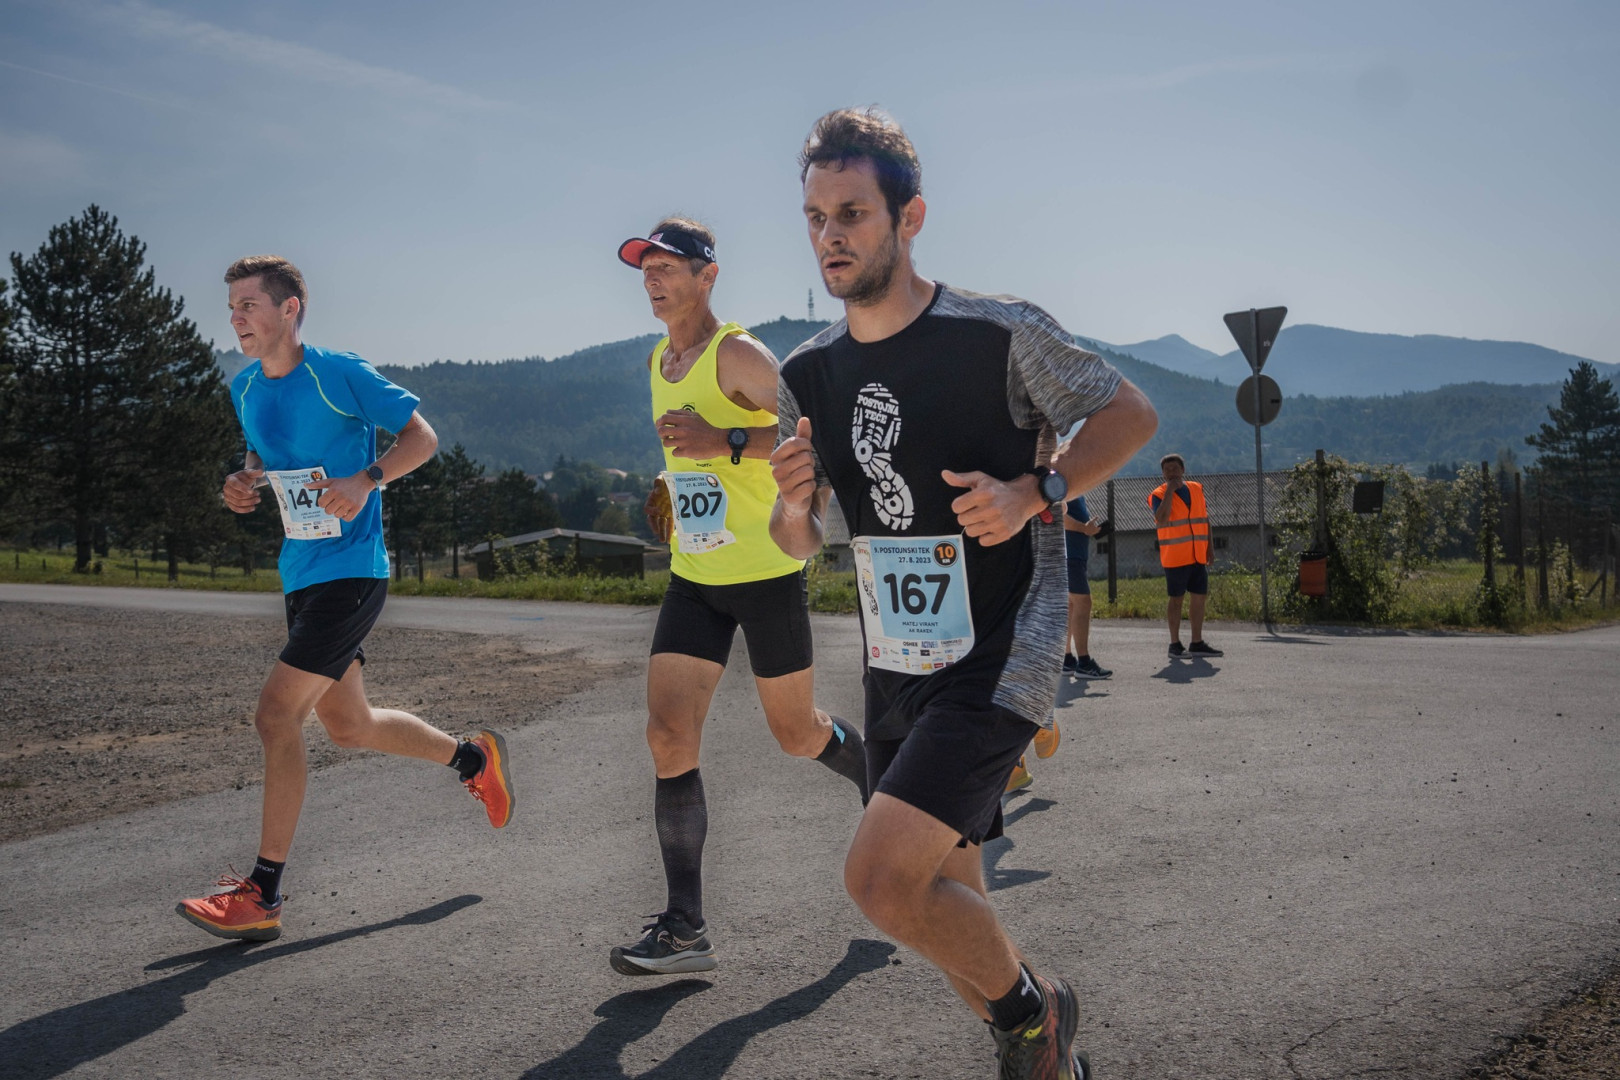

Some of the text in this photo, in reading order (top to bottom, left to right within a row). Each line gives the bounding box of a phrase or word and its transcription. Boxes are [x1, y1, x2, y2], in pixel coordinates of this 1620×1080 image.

[704, 246, 715, 261] CO
[857, 394, 899, 416] POSTOJNA
[288, 488, 323, 510] 147
[678, 491, 722, 518] 207
[880, 546, 918, 554] POSTOJNSKI
[918, 546, 930, 554] TEK
[936, 545, 955, 559] 10
[883, 573, 951, 615] 167
